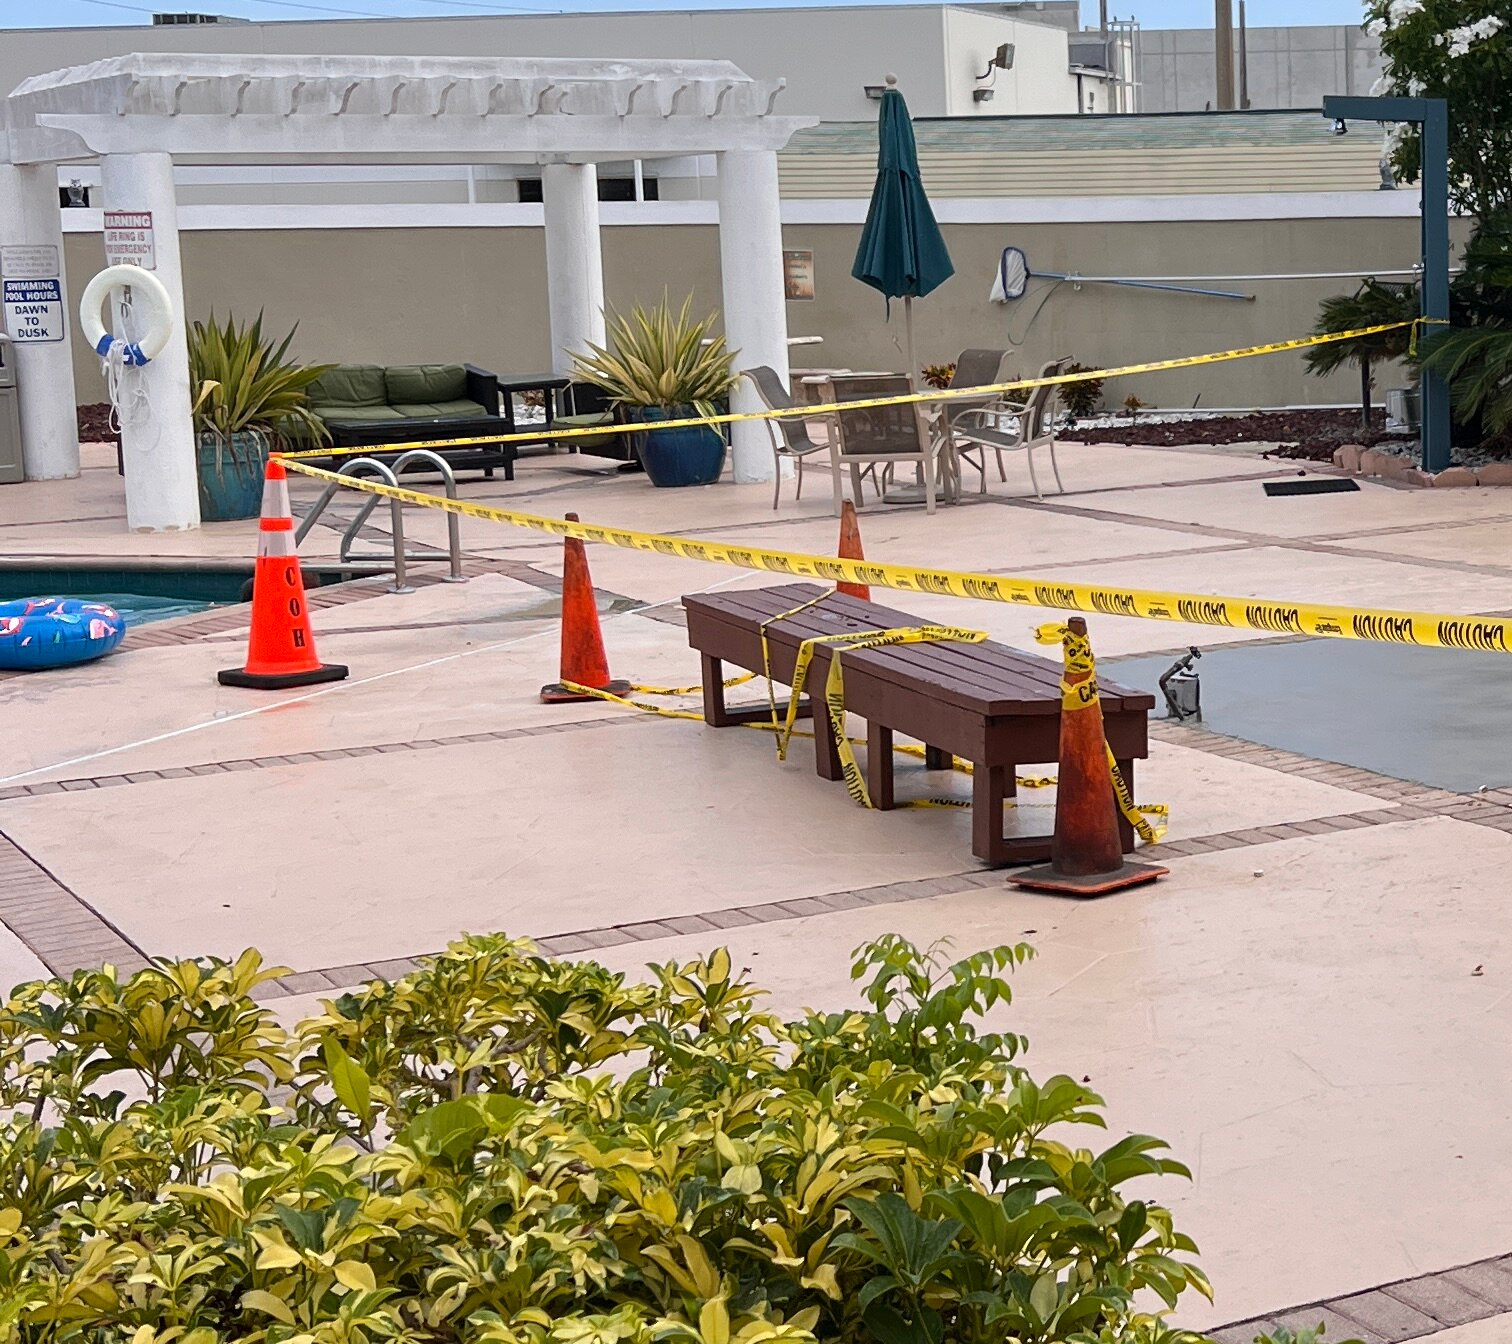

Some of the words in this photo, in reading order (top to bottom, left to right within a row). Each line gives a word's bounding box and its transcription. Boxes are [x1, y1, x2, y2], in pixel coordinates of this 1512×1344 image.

[105, 215, 150, 227] WARNING
[119, 231, 136, 241] RING
[138, 231, 145, 241] IS
[114, 244, 151, 254] EMERGENCY
[123, 256, 142, 266] ONLY
[7, 281, 54, 291] SWIMMING
[5, 292, 24, 301] POOL
[26, 291, 58, 301] HOURS
[15, 305, 48, 315] DAWN
[24, 317, 39, 326] TO
[18, 328, 49, 338] DUSK
[915, 573, 959, 597] CAUTION
[962, 578, 1008, 603] CAUTION
[1035, 586, 1085, 612] CAUTION
[1091, 591, 1143, 618] CAUTION
[1177, 599, 1235, 628] CAUTION
[1246, 605, 1308, 635] CAUTION
[1353, 613, 1420, 645] CAUTION
[1438, 621, 1512, 654] CAUTION
